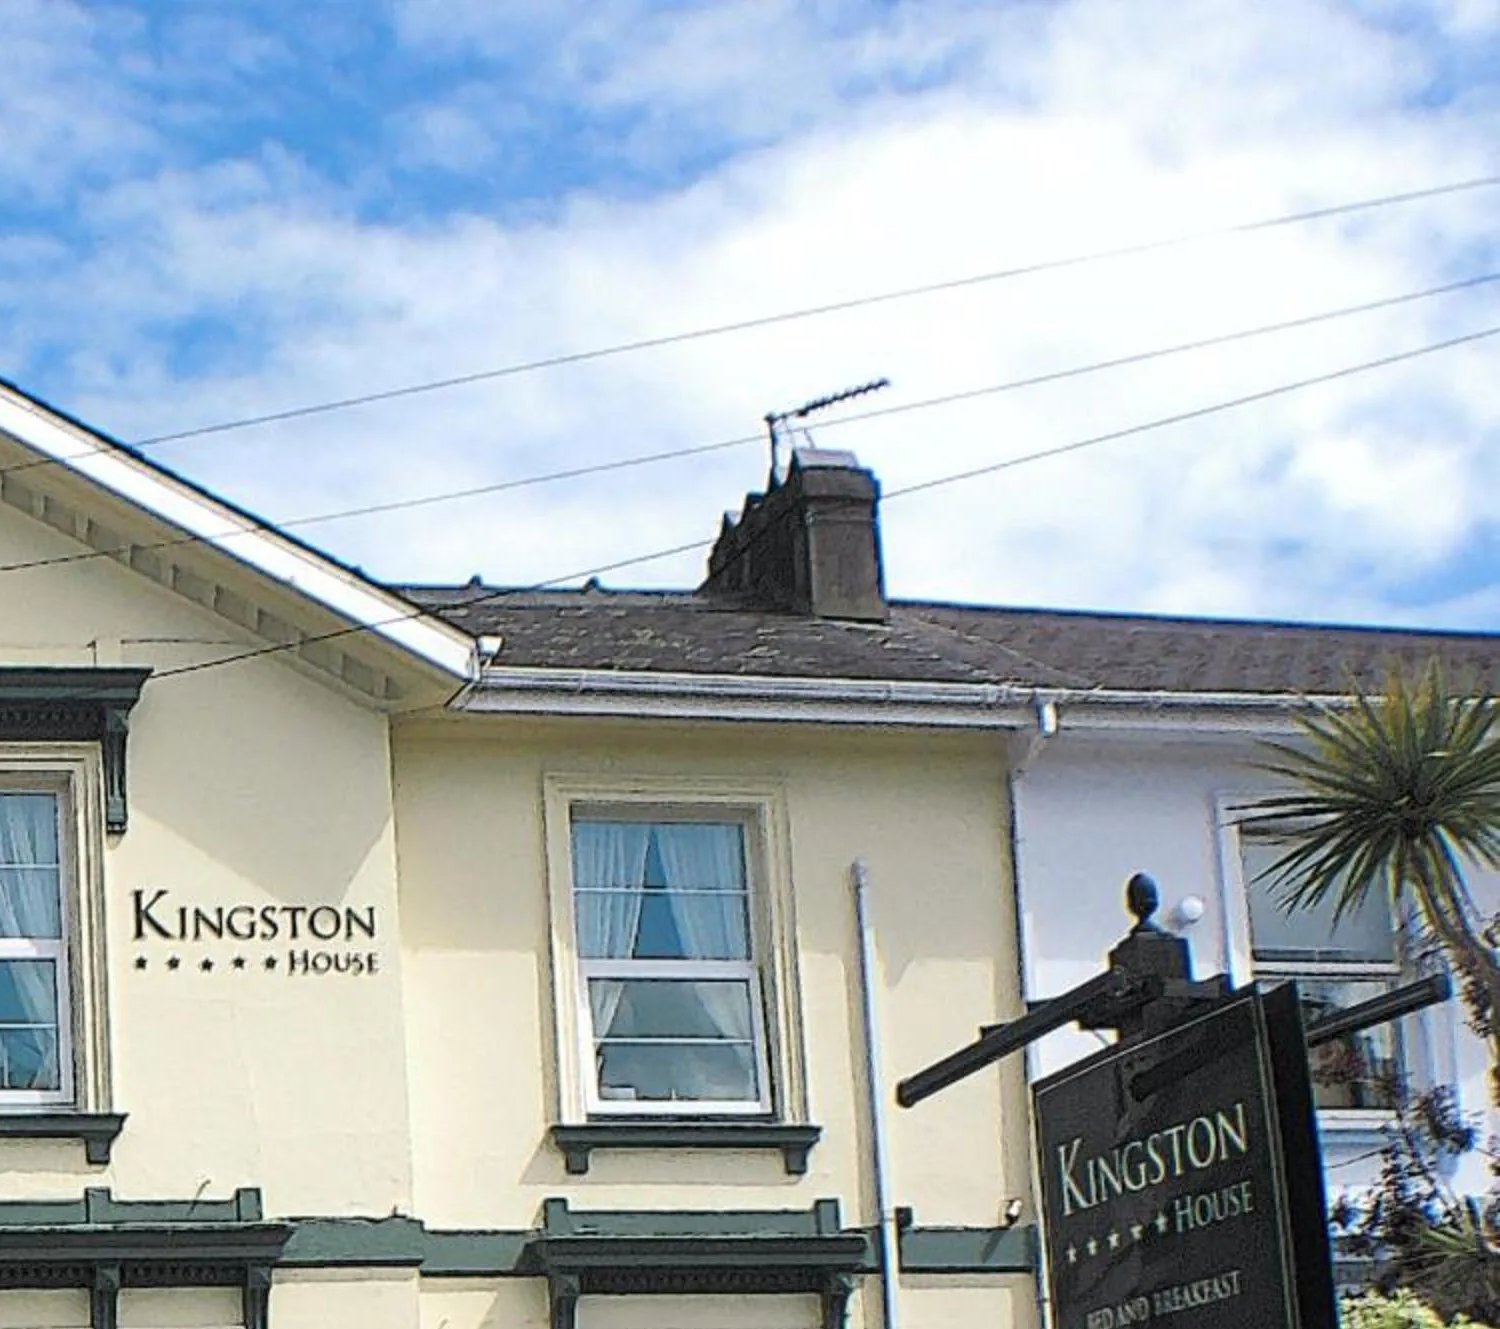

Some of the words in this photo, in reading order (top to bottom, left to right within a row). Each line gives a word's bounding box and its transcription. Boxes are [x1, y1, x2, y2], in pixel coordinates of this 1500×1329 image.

[132, 889, 376, 940] KINGSTON
[288, 949, 378, 975] HOUSE
[1058, 1103, 1248, 1216] KINGSTON
[1174, 1181, 1254, 1233] HOUSE
[1116, 1297, 1149, 1328] AND
[1153, 1270, 1241, 1316] BREAKFAST
